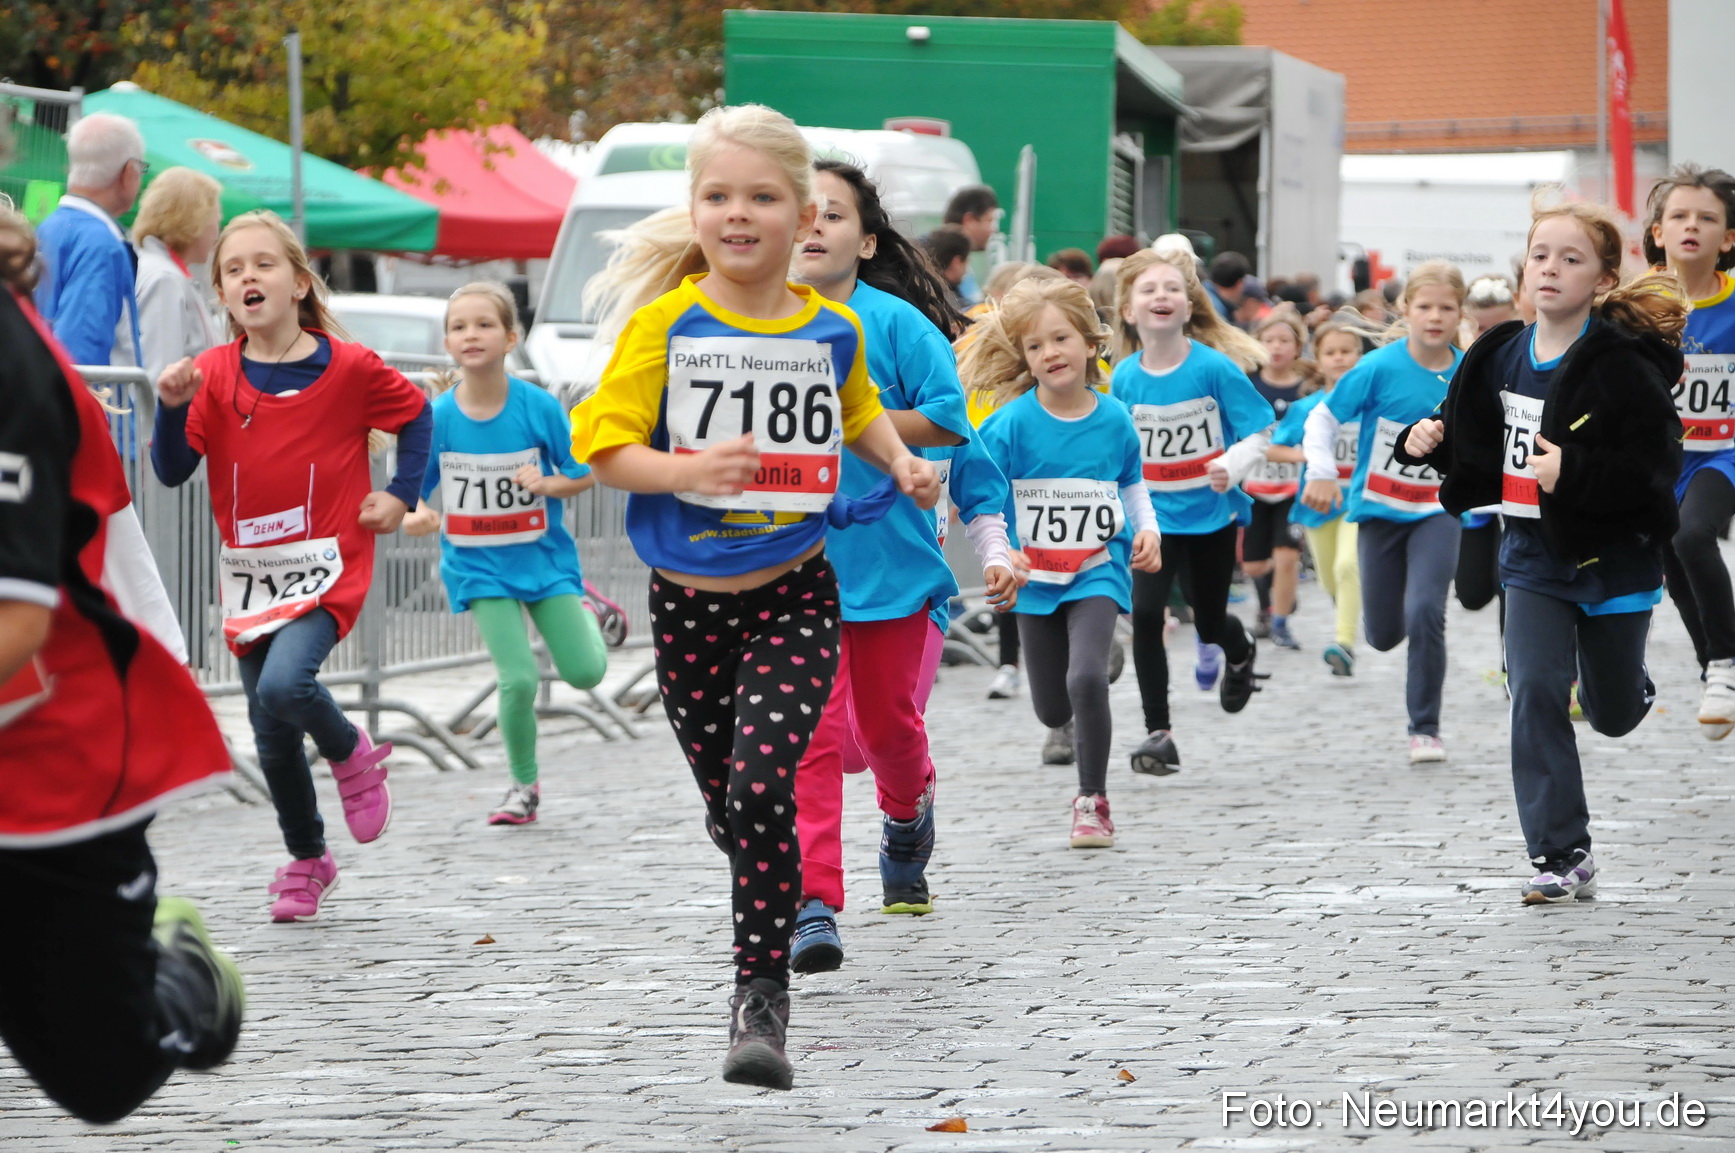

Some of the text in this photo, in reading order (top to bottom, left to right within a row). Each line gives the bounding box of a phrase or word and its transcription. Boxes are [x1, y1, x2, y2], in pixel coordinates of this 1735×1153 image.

[675, 353, 823, 373] PARTL Neumarkt
[690, 379, 833, 445] 7186
[1158, 408, 1203, 422] Neumarkt
[1140, 417, 1212, 458] 7221
[443, 461, 474, 472] PARTL
[1160, 463, 1204, 479] Carolin
[453, 476, 535, 510] 7185
[1016, 489, 1104, 499] PARTL Neumarkt
[254, 520, 284, 535] DEHN
[471, 519, 518, 532] Melina
[1027, 504, 1116, 543] 7579
[258, 552, 318, 568] Neumarkt
[1036, 549, 1071, 571] Marie
[231, 566, 331, 611] 7123
